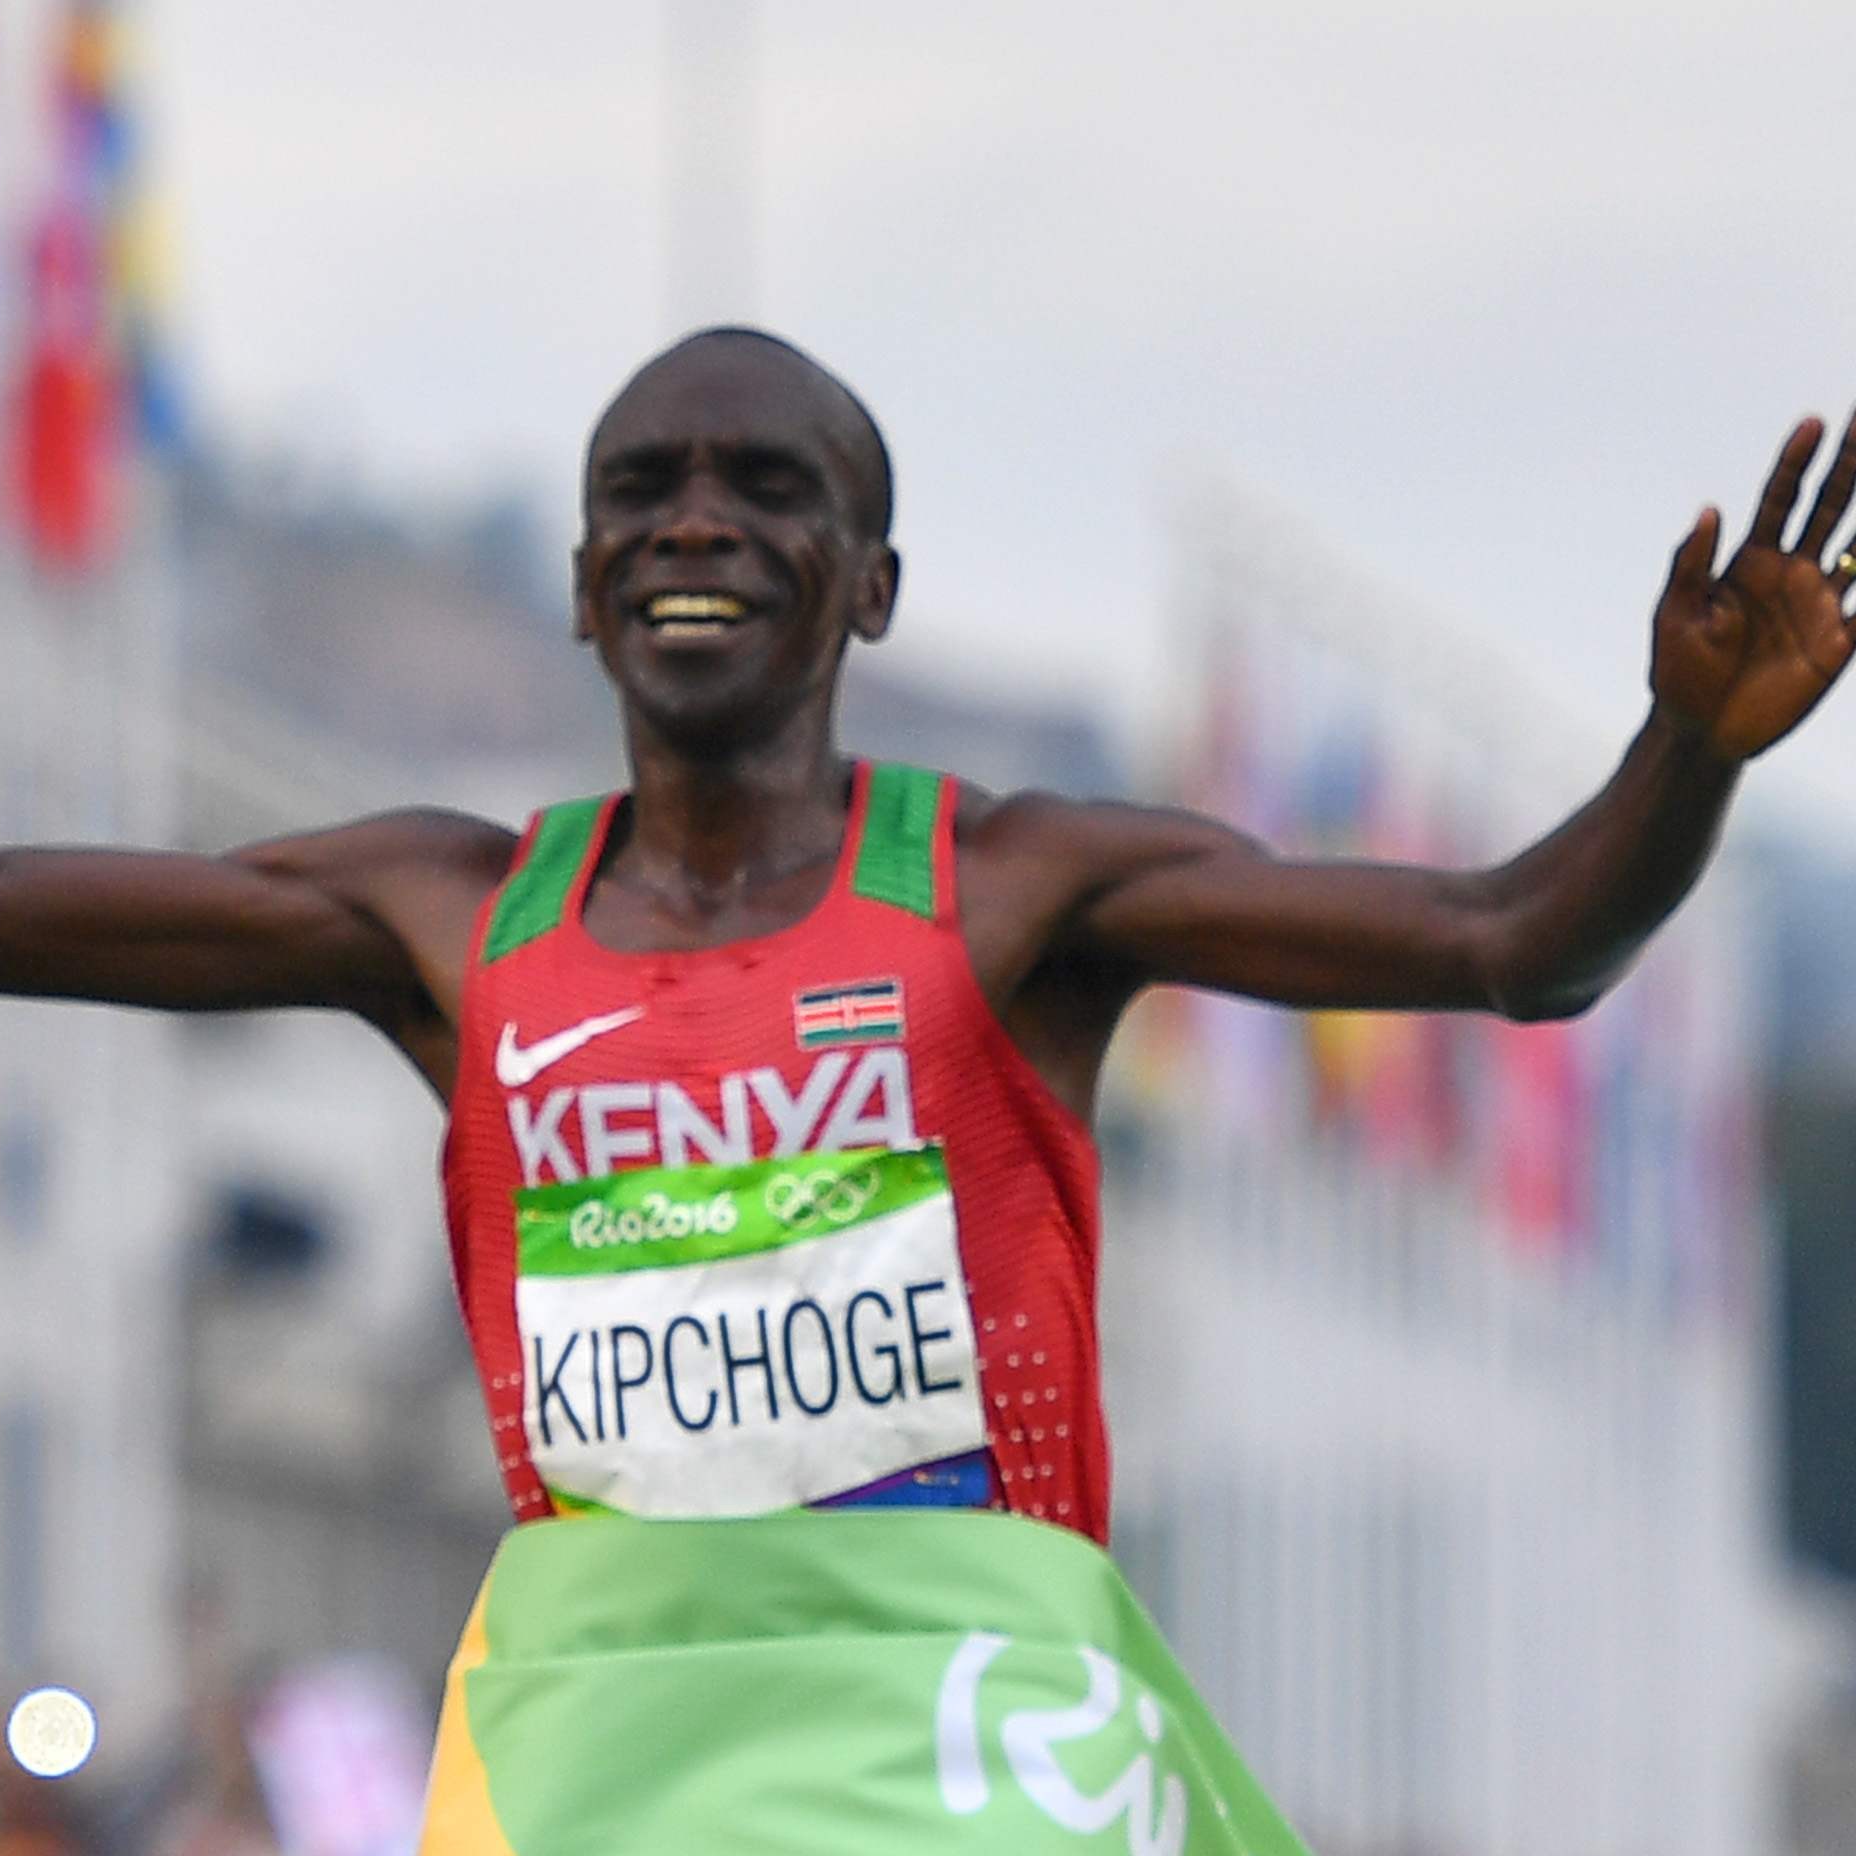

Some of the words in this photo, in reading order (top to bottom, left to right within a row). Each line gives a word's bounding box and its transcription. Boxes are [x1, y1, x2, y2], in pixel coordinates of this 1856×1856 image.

[506, 1048, 914, 1188] KENYA
[569, 1190, 739, 1249] Rio2016
[532, 1281, 962, 1445] KIPCHOGE
